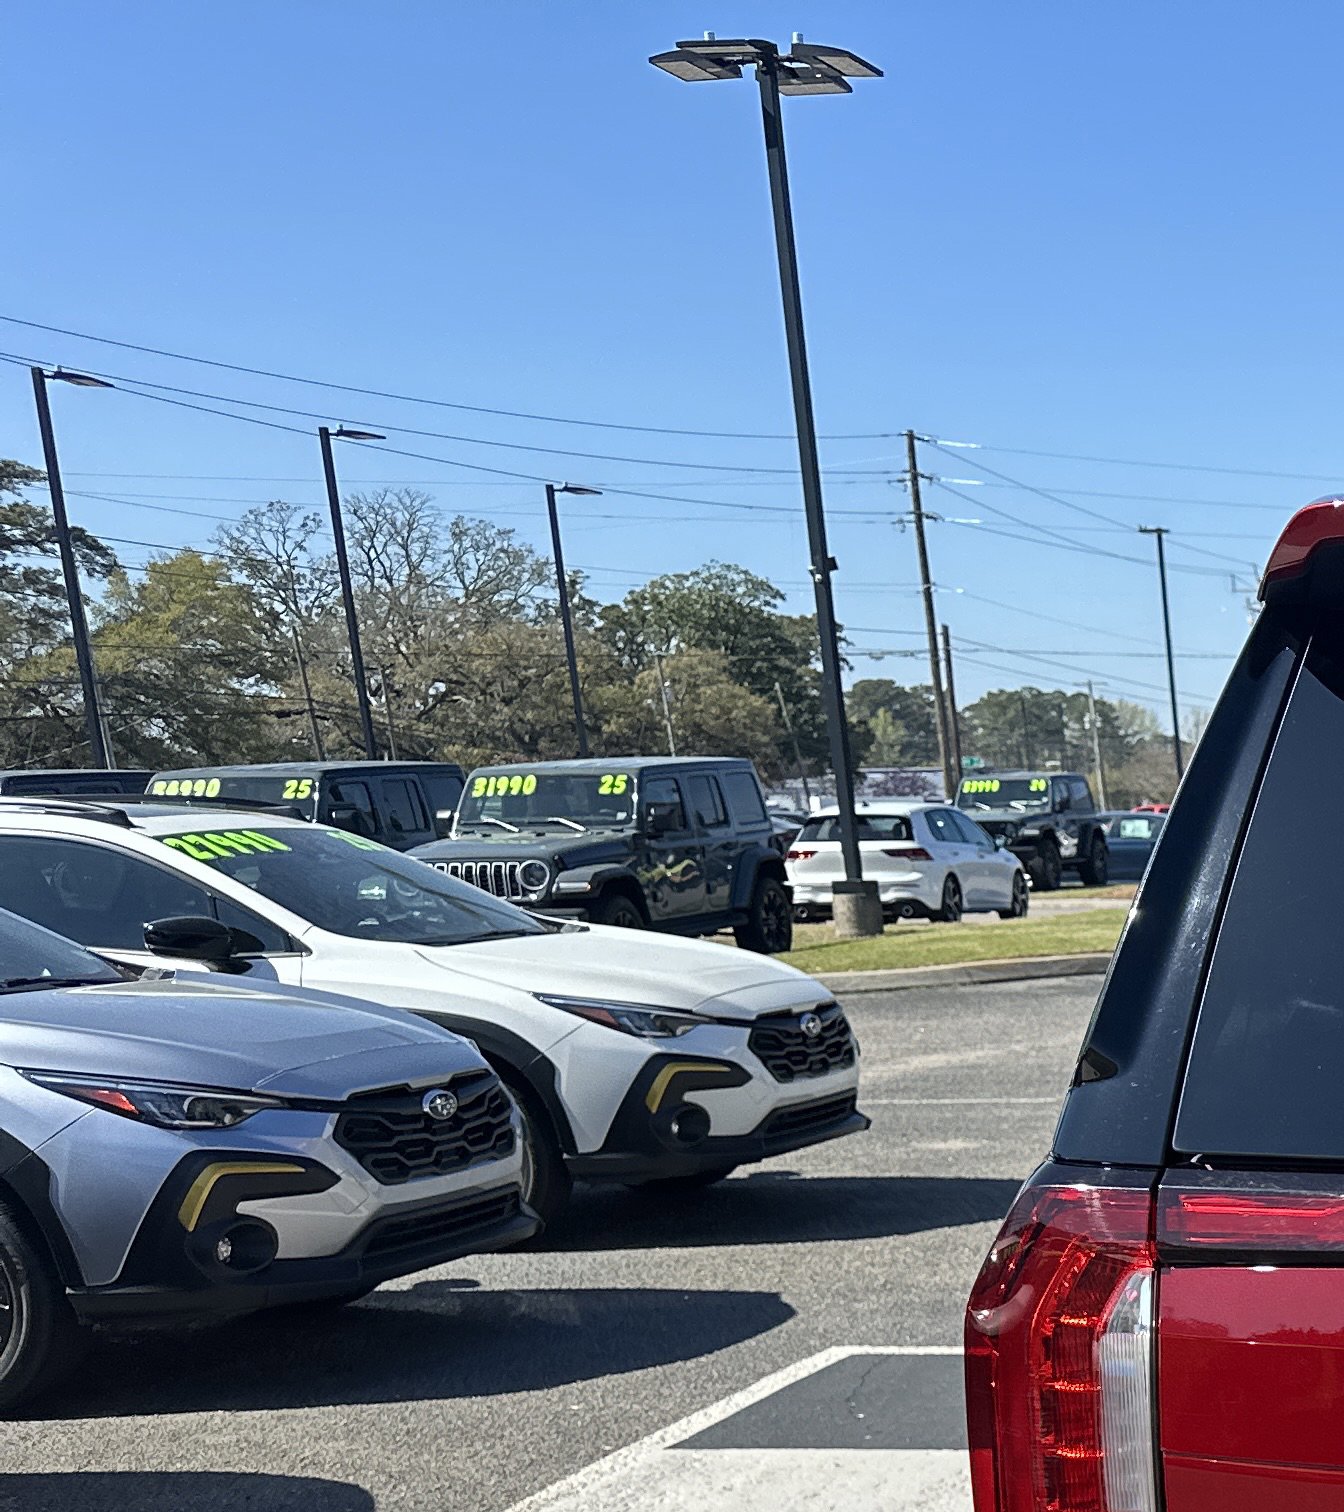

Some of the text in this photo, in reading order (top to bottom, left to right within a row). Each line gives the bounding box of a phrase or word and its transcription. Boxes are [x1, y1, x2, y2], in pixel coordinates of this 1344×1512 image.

[283, 779, 313, 800] 25
[472, 774, 628, 797] 31990 25
[162, 829, 293, 860] 27990
